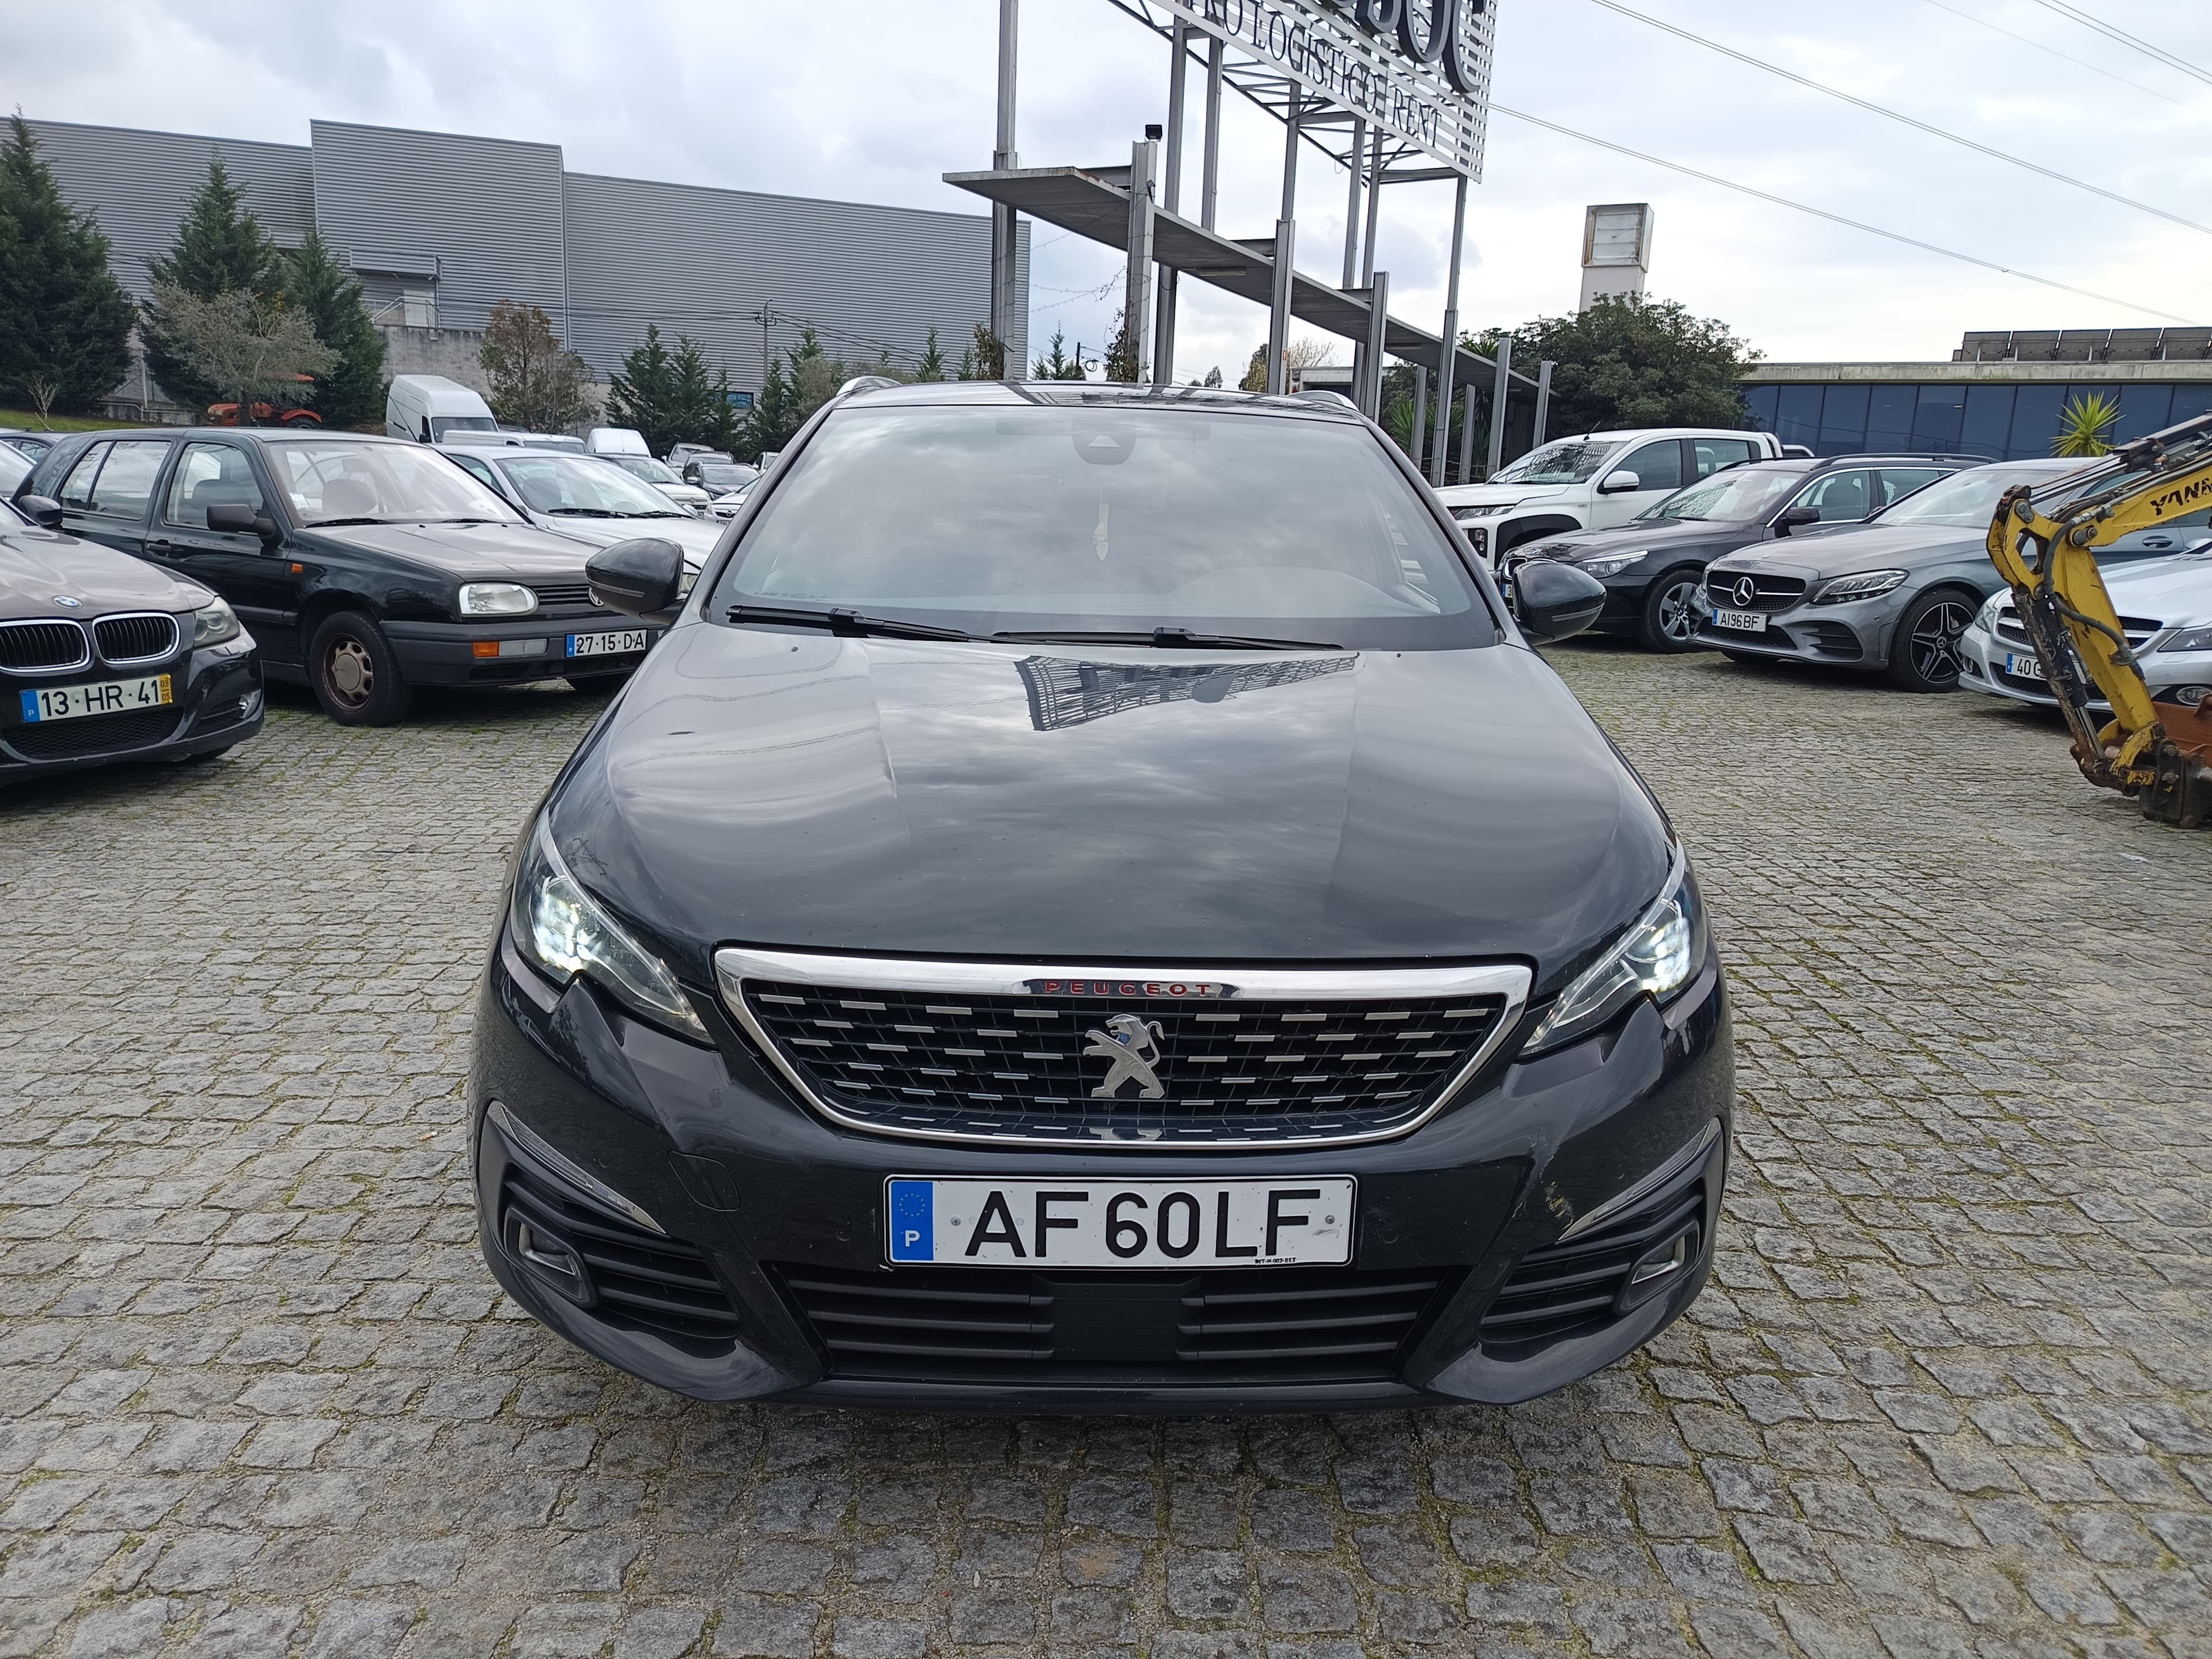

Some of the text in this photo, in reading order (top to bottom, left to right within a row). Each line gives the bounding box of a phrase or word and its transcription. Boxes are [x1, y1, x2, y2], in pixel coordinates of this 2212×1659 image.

[1391, 88, 1442, 148] RENT
[160, 679, 169, 688] 09
[161, 692, 171, 701] 05
[28, 709, 35, 717] P
[1045, 981, 1211, 997] PEUGEOT
[904, 1229, 921, 1247] P
